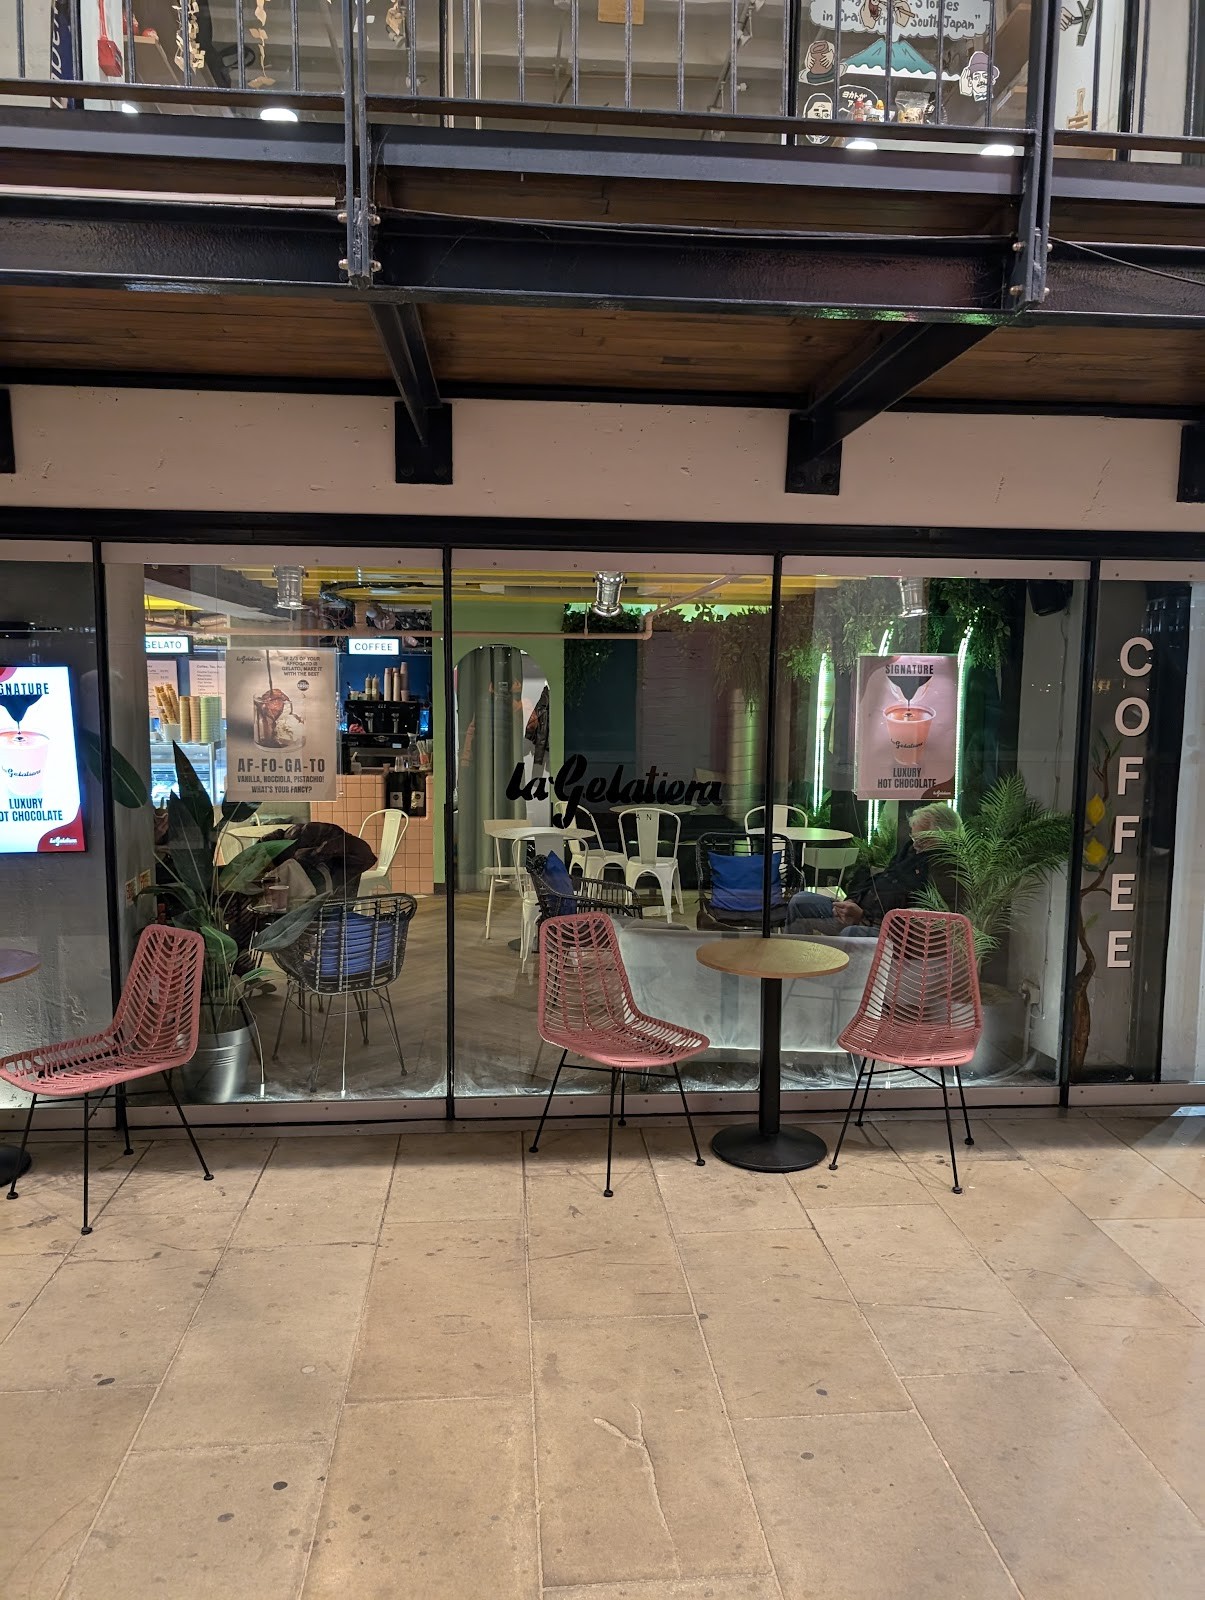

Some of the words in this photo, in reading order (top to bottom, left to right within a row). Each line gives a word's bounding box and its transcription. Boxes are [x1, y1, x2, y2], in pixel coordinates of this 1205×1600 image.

[822, 10, 833, 21] in
[145, 640, 182, 649] GELATO
[354, 642, 393, 651] COFFEE
[885, 664, 934, 675] SIGNATURE
[237, 758, 325, 773] AF-FO-GA-TO
[893, 767, 922, 778] LUXURY
[237, 775, 262, 783] VANILLA,
[263, 775, 293, 783] NOCCIOLA,
[294, 775, 325, 783] PISTACHIO!
[877, 779, 892, 789] HOT
[894, 778, 937, 789] CHOCOLATE
[290, 786, 313, 794] FANCY?
[551, 754, 723, 829] Gelatiera
[8, 798, 43, 810] LUXURY
[1106, 636, 1155, 968] COFFEE
[12, 810, 64, 822] CHOCOLATE
